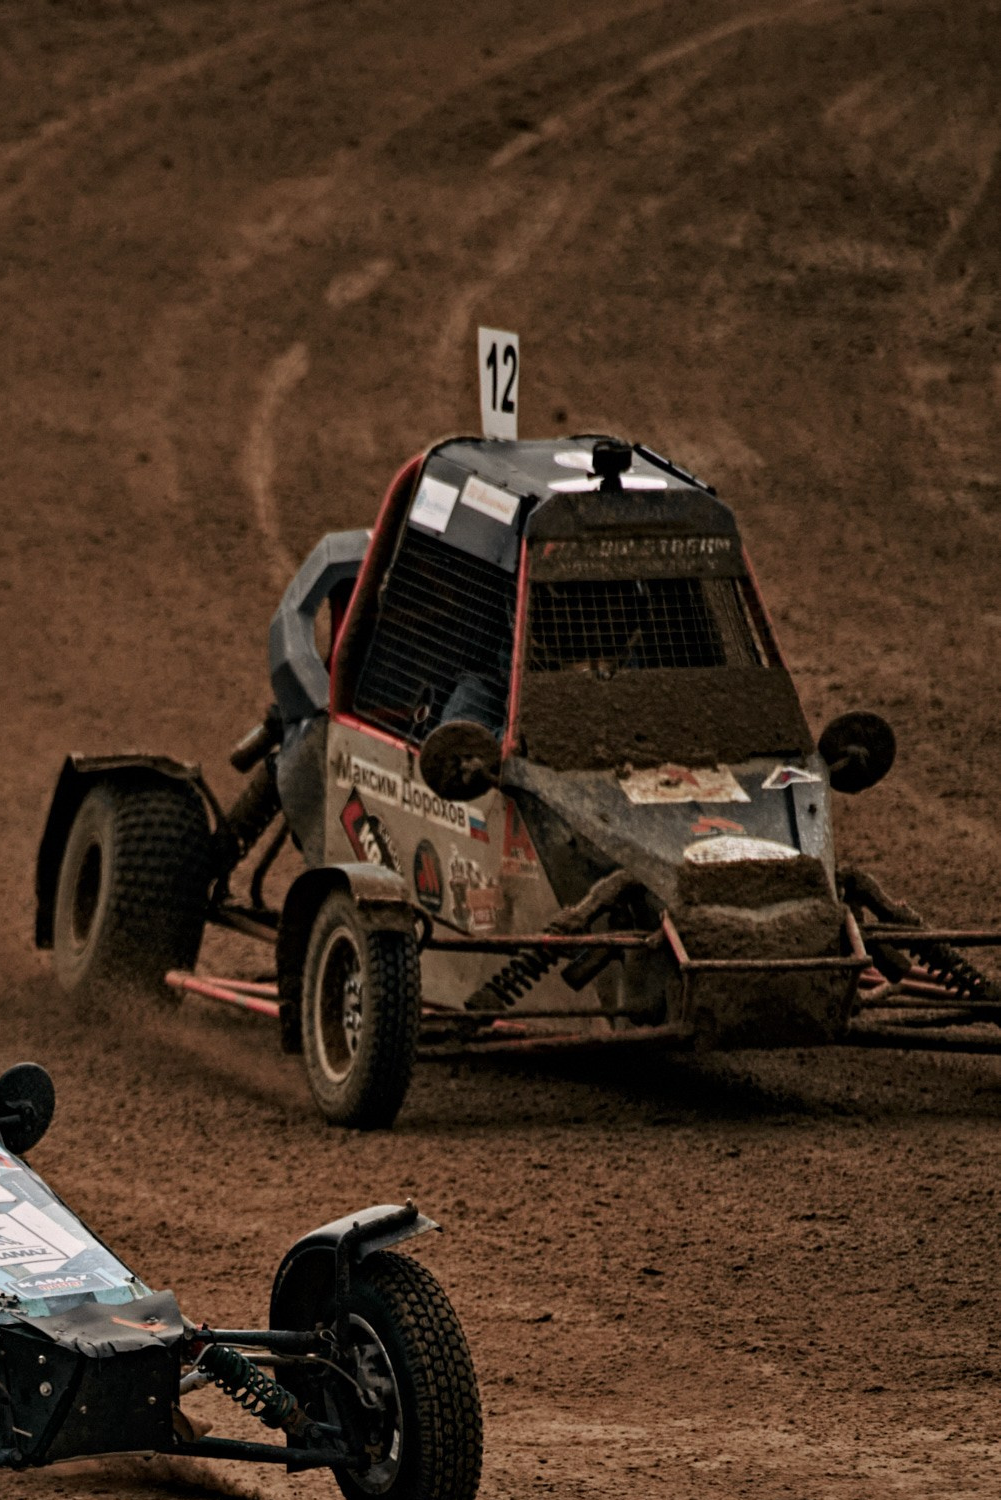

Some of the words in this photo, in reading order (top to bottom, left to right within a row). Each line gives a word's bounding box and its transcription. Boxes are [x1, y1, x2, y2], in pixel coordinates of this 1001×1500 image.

[486, 342, 517, 414] 12
[336, 751, 397, 798] Максим
[402, 778, 466, 828] Дорохов
[17, 1274, 91, 1288] KAMAZ
